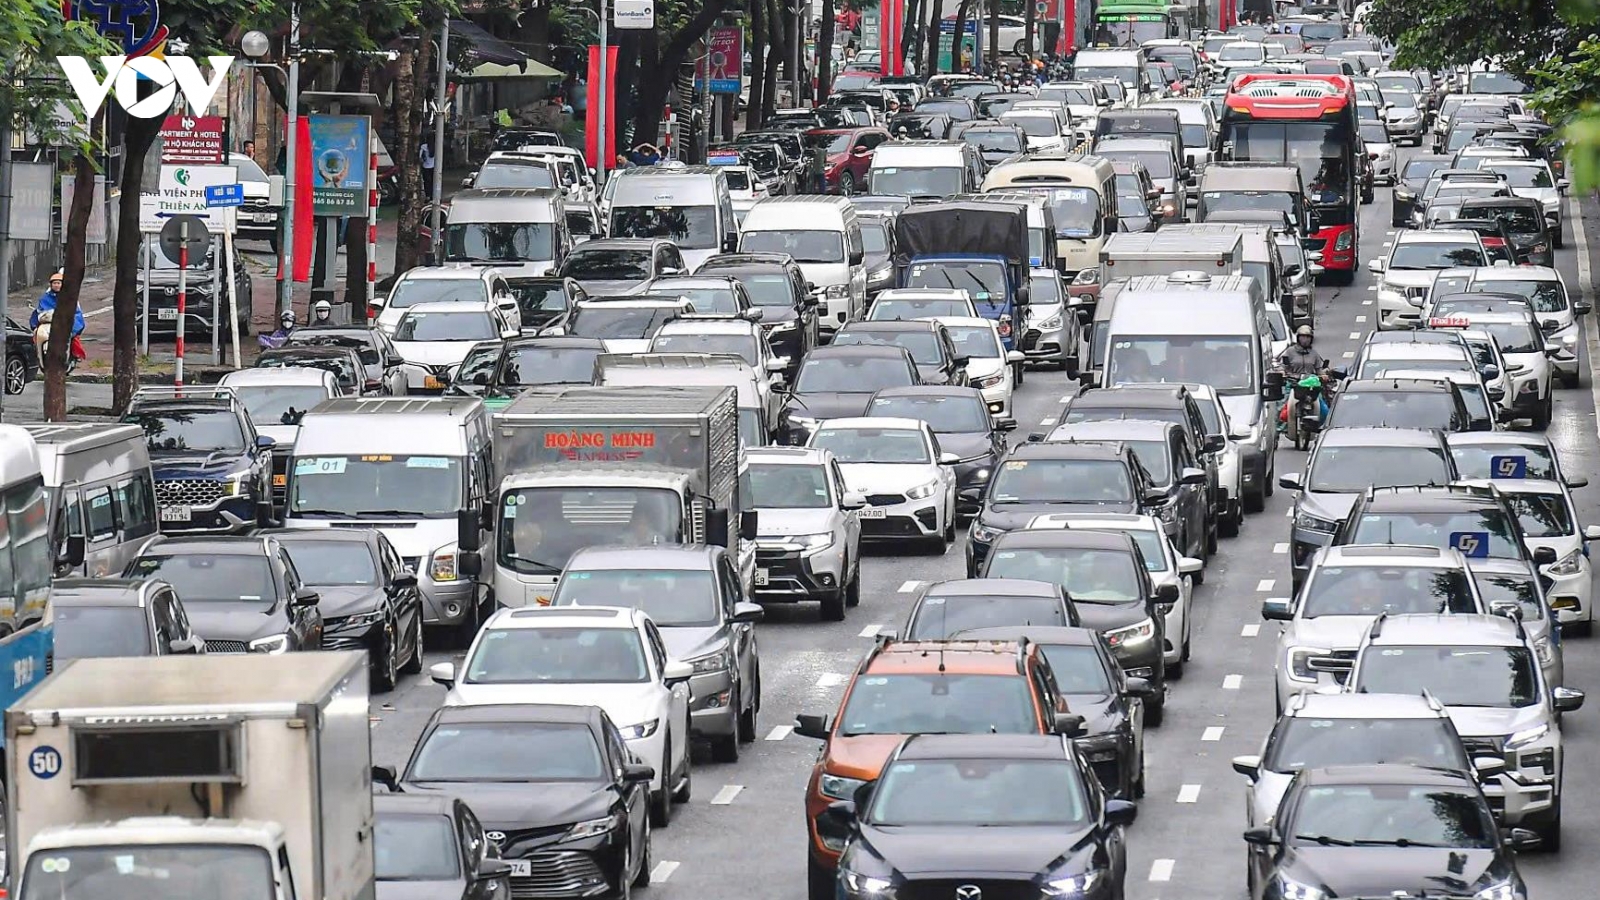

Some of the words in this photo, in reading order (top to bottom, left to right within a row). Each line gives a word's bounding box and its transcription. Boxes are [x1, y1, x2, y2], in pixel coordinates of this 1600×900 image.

[182, 138, 204, 148] KHÁCH
[1433, 317, 1448, 326] Taxi
[545, 430, 605, 448] HOÀNG
[611, 432, 655, 448] MINH
[577, 451, 626, 461] EXPRESS
[321, 460, 339, 471] 01
[1498, 457, 1518, 477] G7
[1458, 534, 1479, 555] G7
[32, 751, 59, 774] 50
